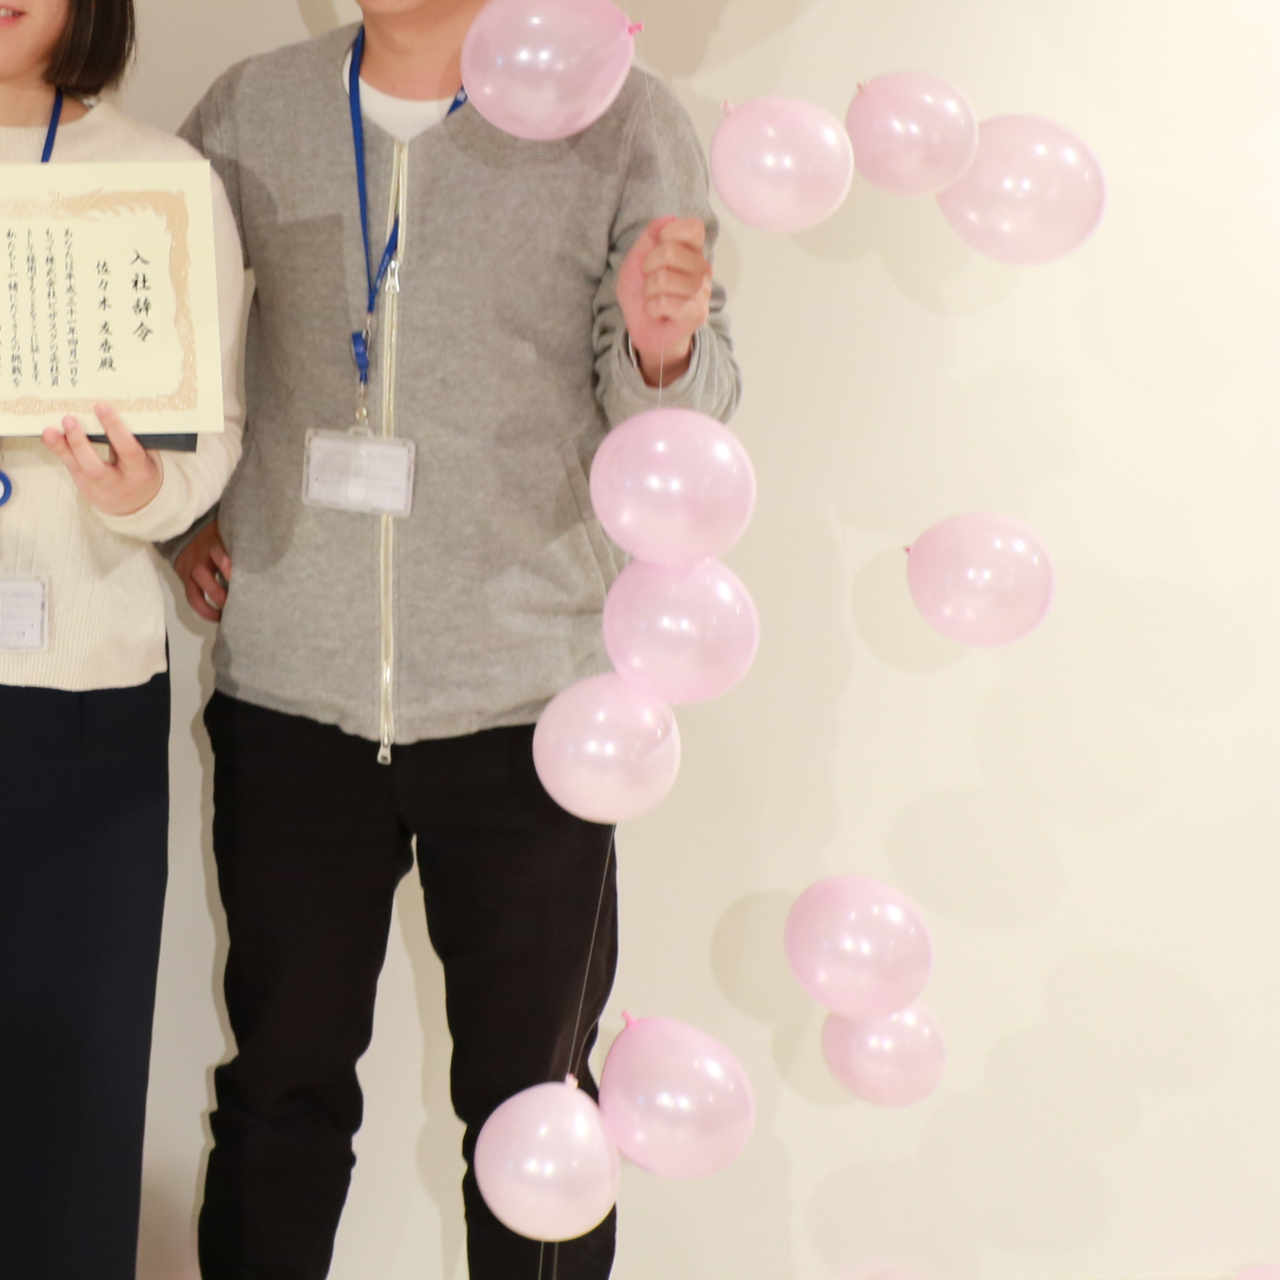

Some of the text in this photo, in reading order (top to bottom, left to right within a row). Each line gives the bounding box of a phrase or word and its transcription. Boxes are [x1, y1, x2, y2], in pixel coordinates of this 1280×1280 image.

[95, 259, 111, 311] 佐々木
[130, 249, 153, 342] 入社辞令
